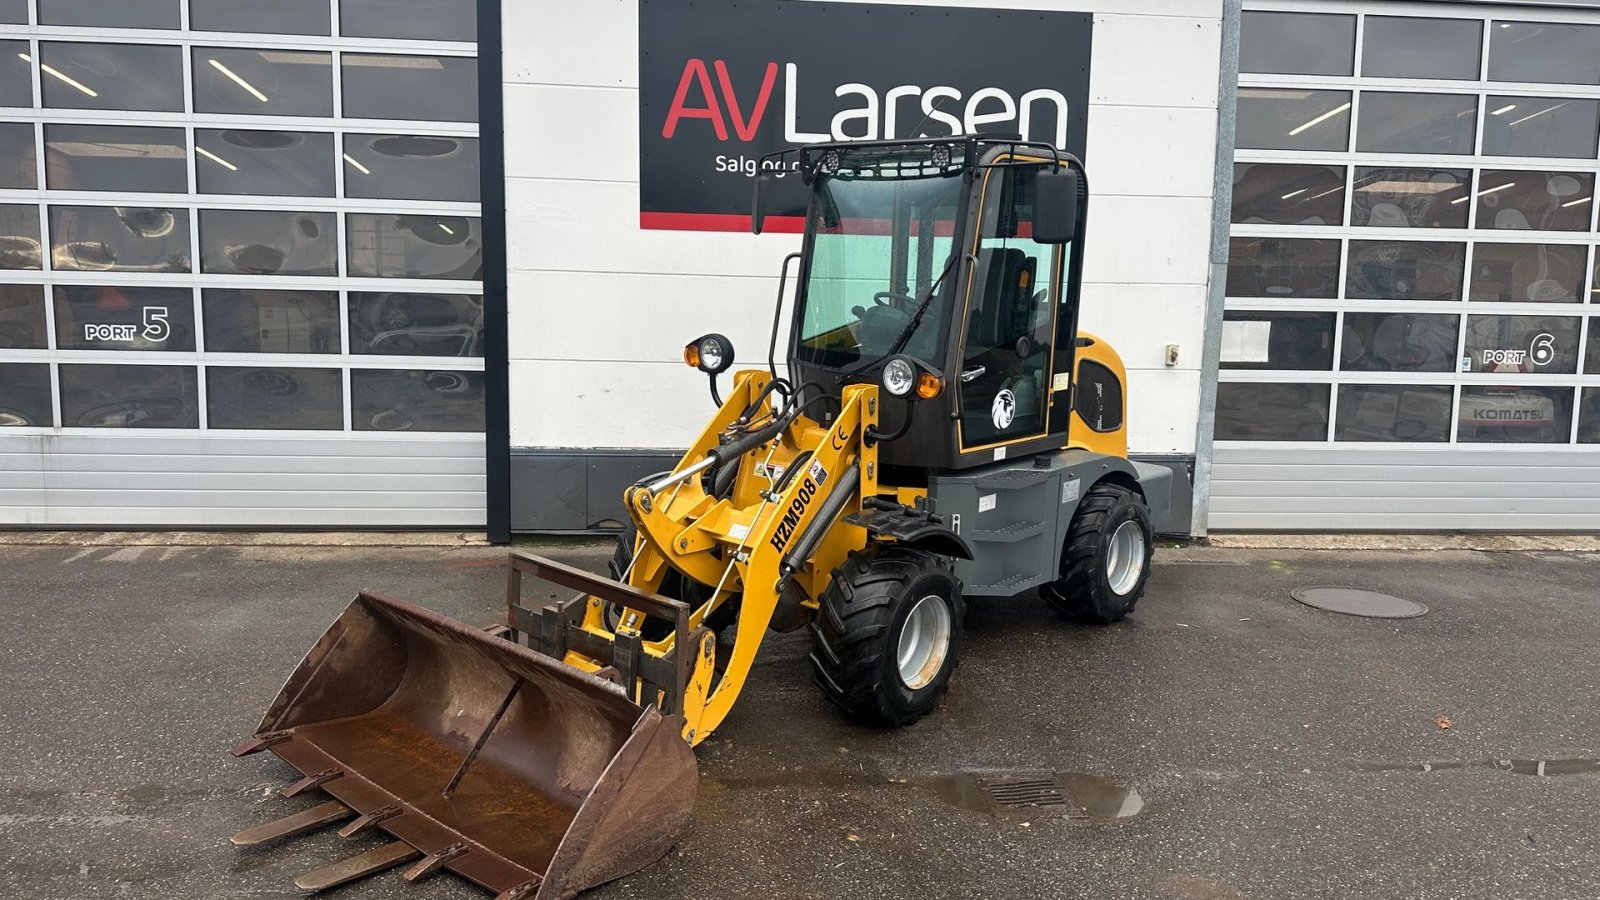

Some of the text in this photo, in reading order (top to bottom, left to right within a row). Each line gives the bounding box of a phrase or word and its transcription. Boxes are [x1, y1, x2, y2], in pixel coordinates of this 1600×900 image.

[715, 155, 757, 177] Salg
[85, 306, 170, 342] PORT 5
[1483, 349, 1526, 365] PORT
[1529, 333, 1555, 366] 6
[1473, 408, 1544, 420] KOMATSU
[832, 425, 848, 450] CE
[769, 478, 817, 553] HZM908
